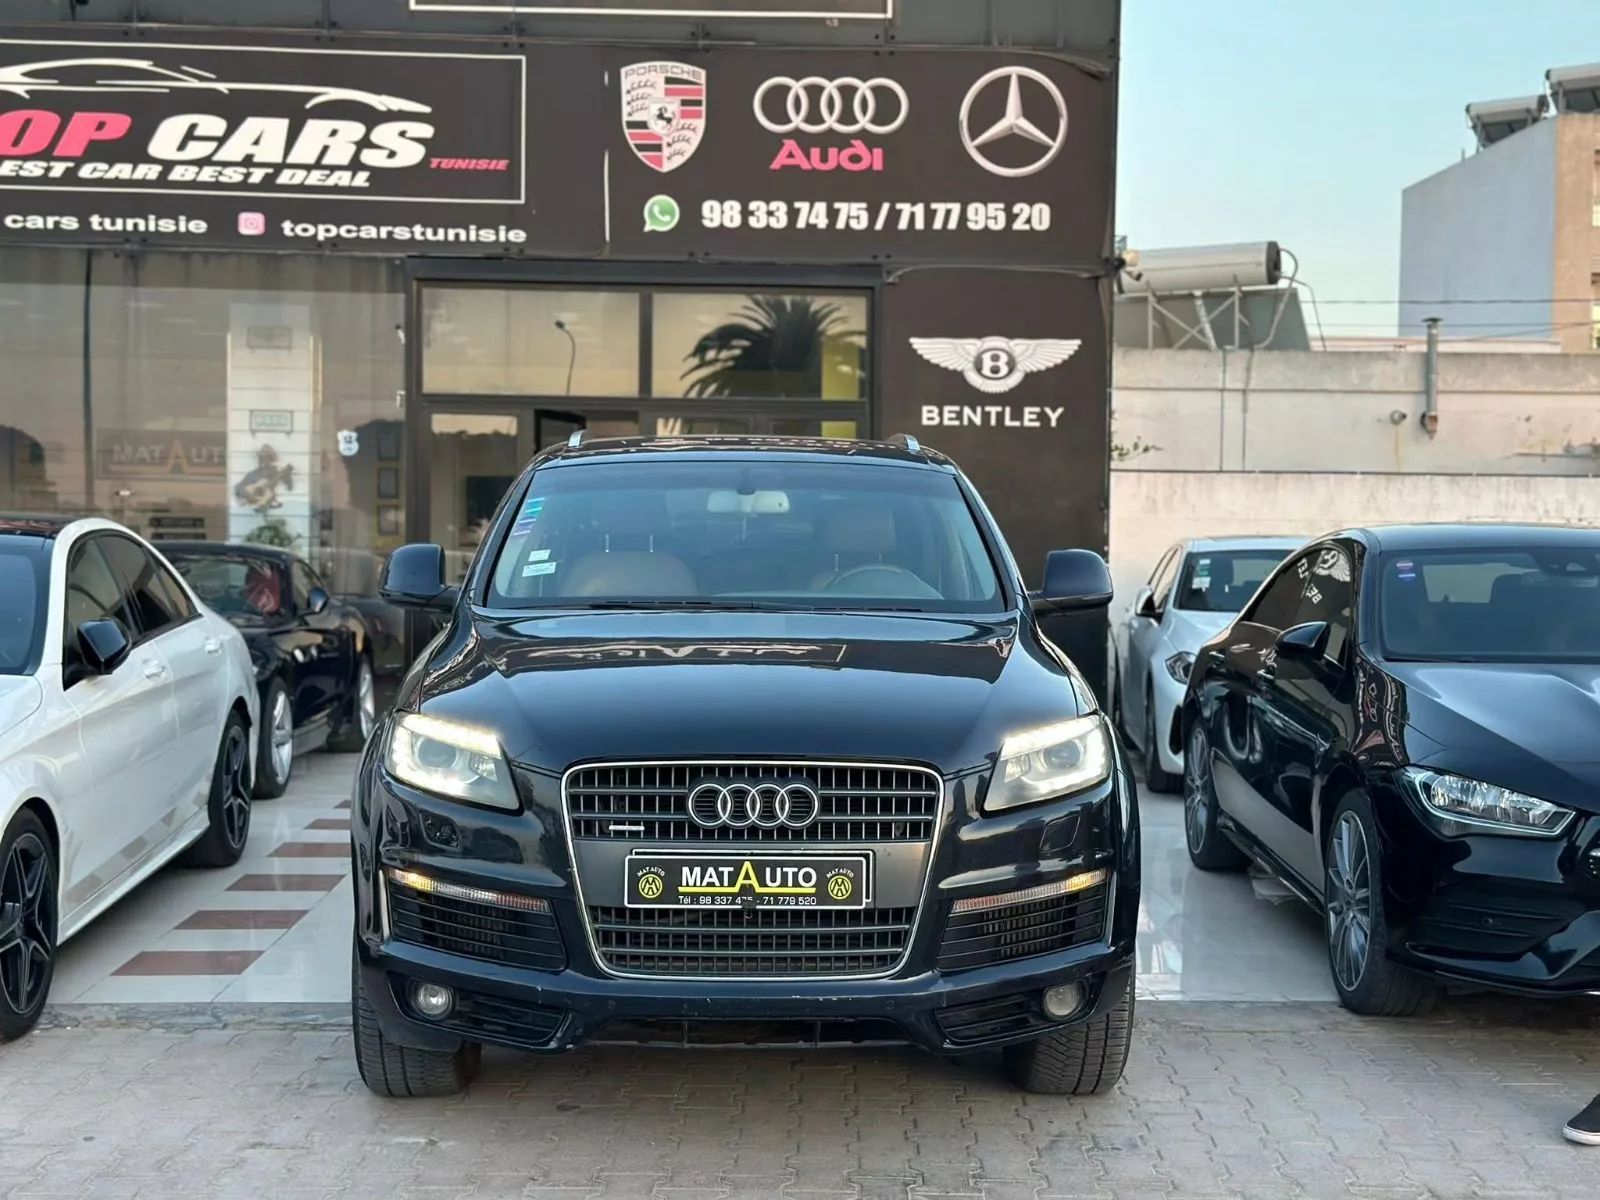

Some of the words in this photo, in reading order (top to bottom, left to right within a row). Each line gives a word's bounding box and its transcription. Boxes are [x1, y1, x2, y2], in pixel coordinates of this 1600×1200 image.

[625, 64, 702, 80] PORSCHE
[147, 113, 435, 168] CARS
[429, 157, 510, 171] TUNISIE
[769, 139, 883, 171] Audi
[77, 162, 163, 180] CAR
[167, 165, 273, 184] BEST
[276, 168, 371, 187] DEAL
[4, 214, 80, 230] cars
[89, 214, 208, 234] tunisie
[701, 200, 742, 228] 98
[748, 200, 788, 229] 33
[793, 201, 829, 229] 74
[833, 202, 869, 230] 75
[895, 202, 925, 231] 71
[930, 202, 961, 231] 77
[966, 202, 1006, 231] 95
[1012, 202, 1051, 231] 20
[281, 219, 527, 243] topcarstunisie
[921, 405, 1064, 427] BENTLEY
[112, 438, 226, 474] MATAUT
[679, 896, 691, 904] Tél
[700, 896, 711, 904] 98
[715, 896, 733, 904] 337
[763, 896, 774, 905] 71
[778, 896, 796, 905] 779
[799, 896, 817, 905] 520
